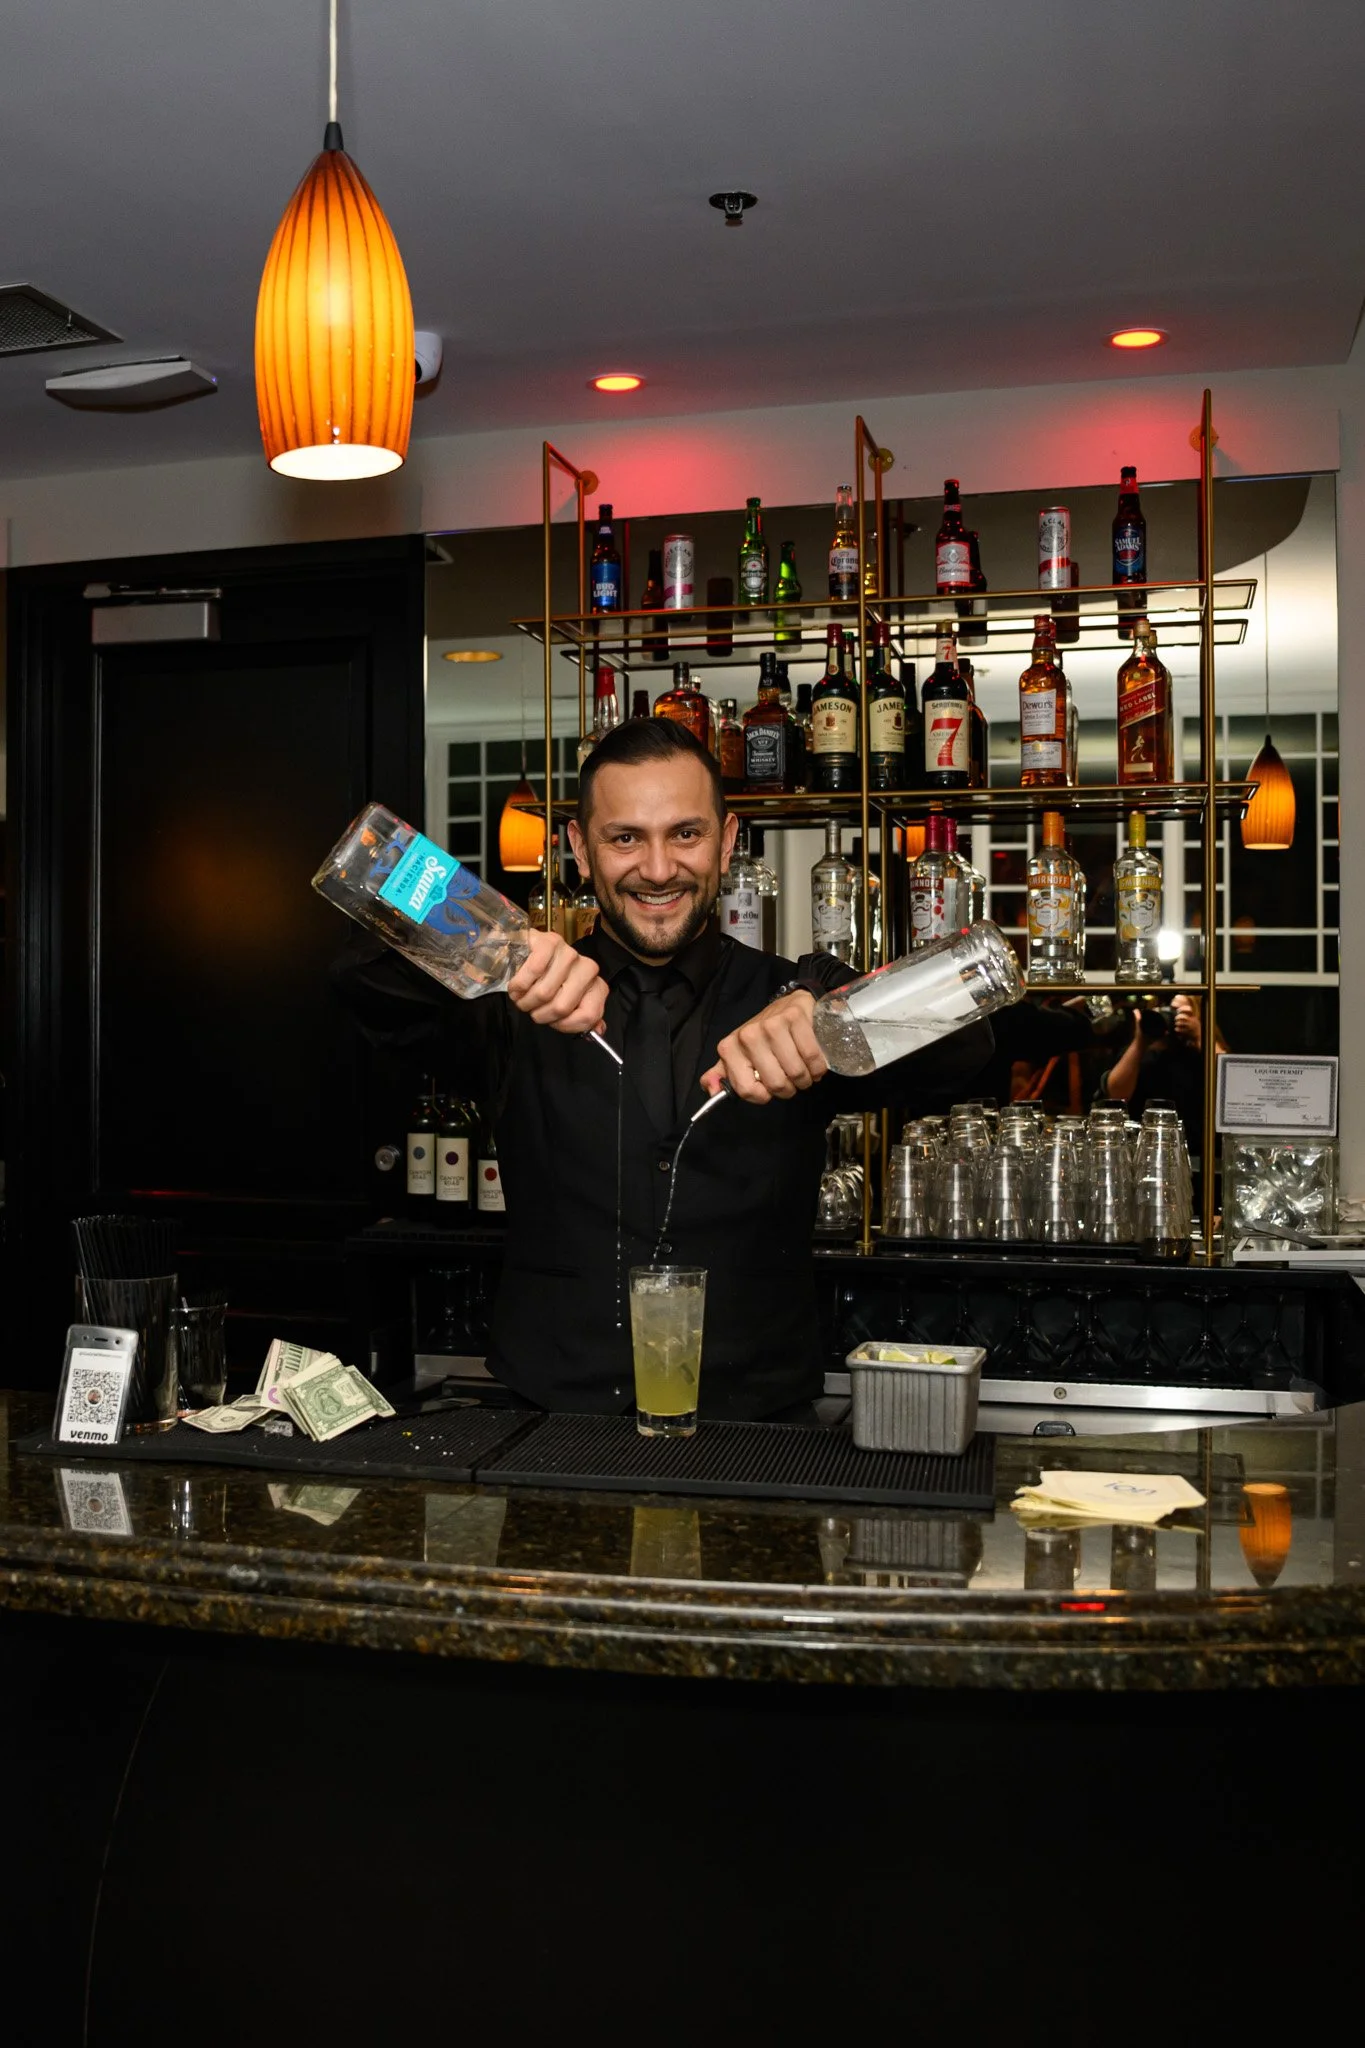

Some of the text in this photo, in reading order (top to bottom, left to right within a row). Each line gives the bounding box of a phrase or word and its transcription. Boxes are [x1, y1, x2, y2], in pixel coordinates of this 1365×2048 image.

[942, 646, 952, 660] 7
[813, 701, 852, 716] JAMESON
[930, 717, 963, 767] 7
[408, 855, 447, 910] Sauza
[1028, 876, 1068, 885] SMIRNOFF
[70, 1430, 109, 1441] venmo
